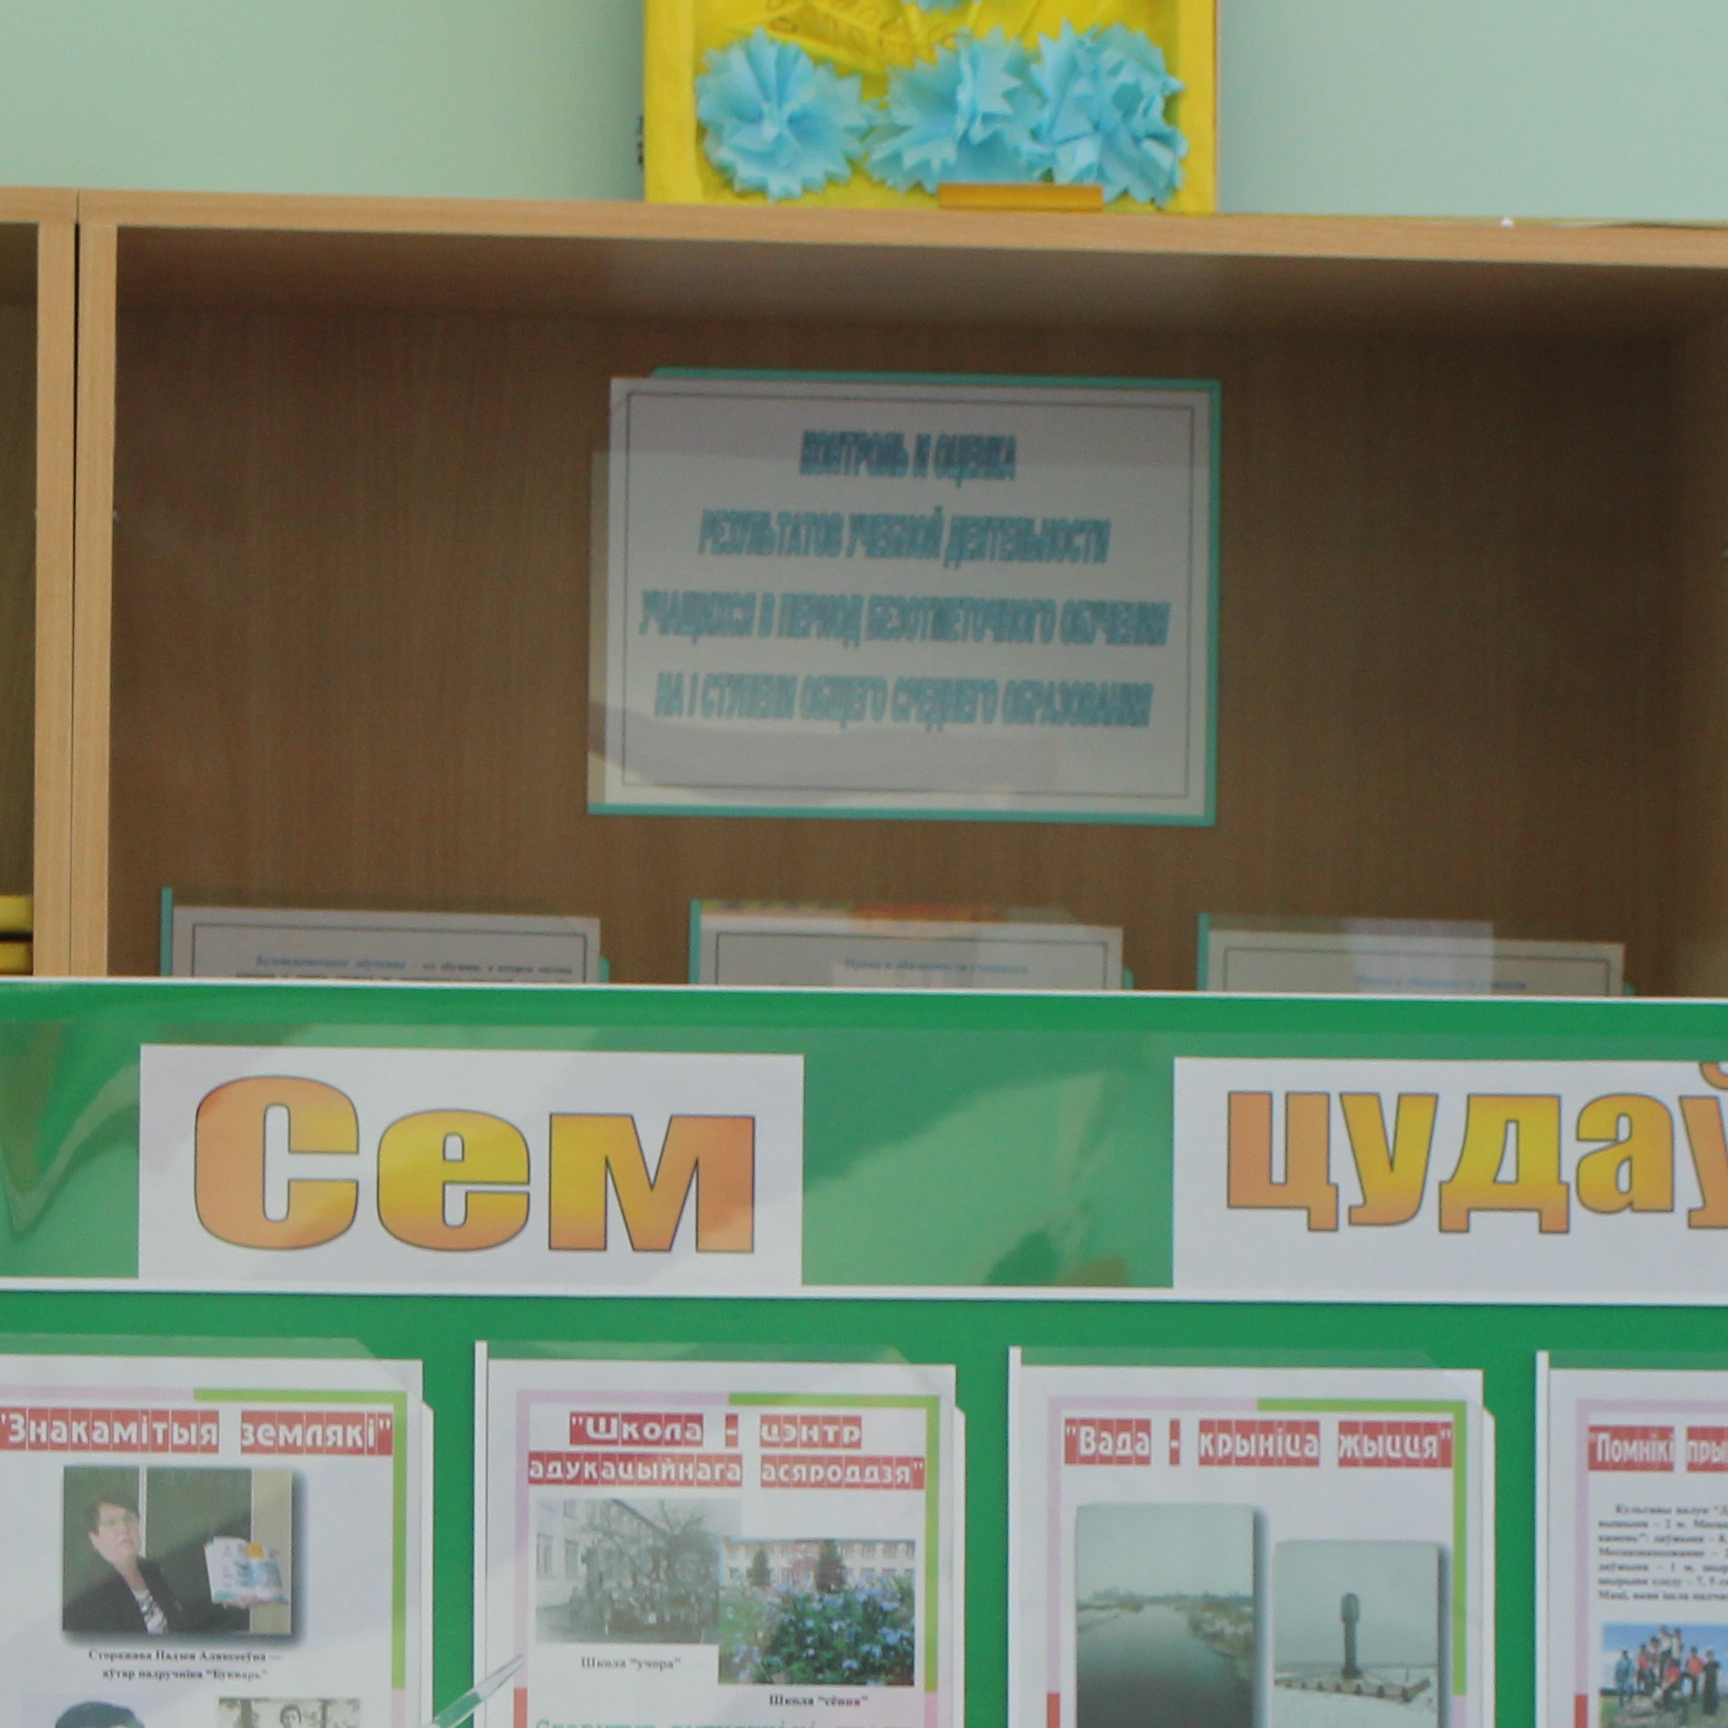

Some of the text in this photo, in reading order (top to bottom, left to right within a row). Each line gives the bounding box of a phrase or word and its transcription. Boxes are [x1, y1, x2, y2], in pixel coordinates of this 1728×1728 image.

[799, 430, 1017, 487] КОНТРОЛЬ И ОЦЕНКА
[698, 508, 844, 559] РЕЗУЛЬТАТОВ
[846, 505, 944, 561] УЧЕБНОЙ
[776, 592, 865, 648] ПЕРИОД
[654, 671, 685, 718] НА
[193, 1073, 757, 1254] Сем
[241, 1414, 391, 1449] землякі"
[572, 1413, 703, 1442] "Школа
[761, 1421, 862, 1447] цэнтр
[1065, 1424, 1152, 1458] "Вада
[1199, 1426, 1320, 1461] крыніца
[1338, 1428, 1453, 1461] жыцця"
[529, 1453, 924, 1488] адукацыйнага асяроддзя"
